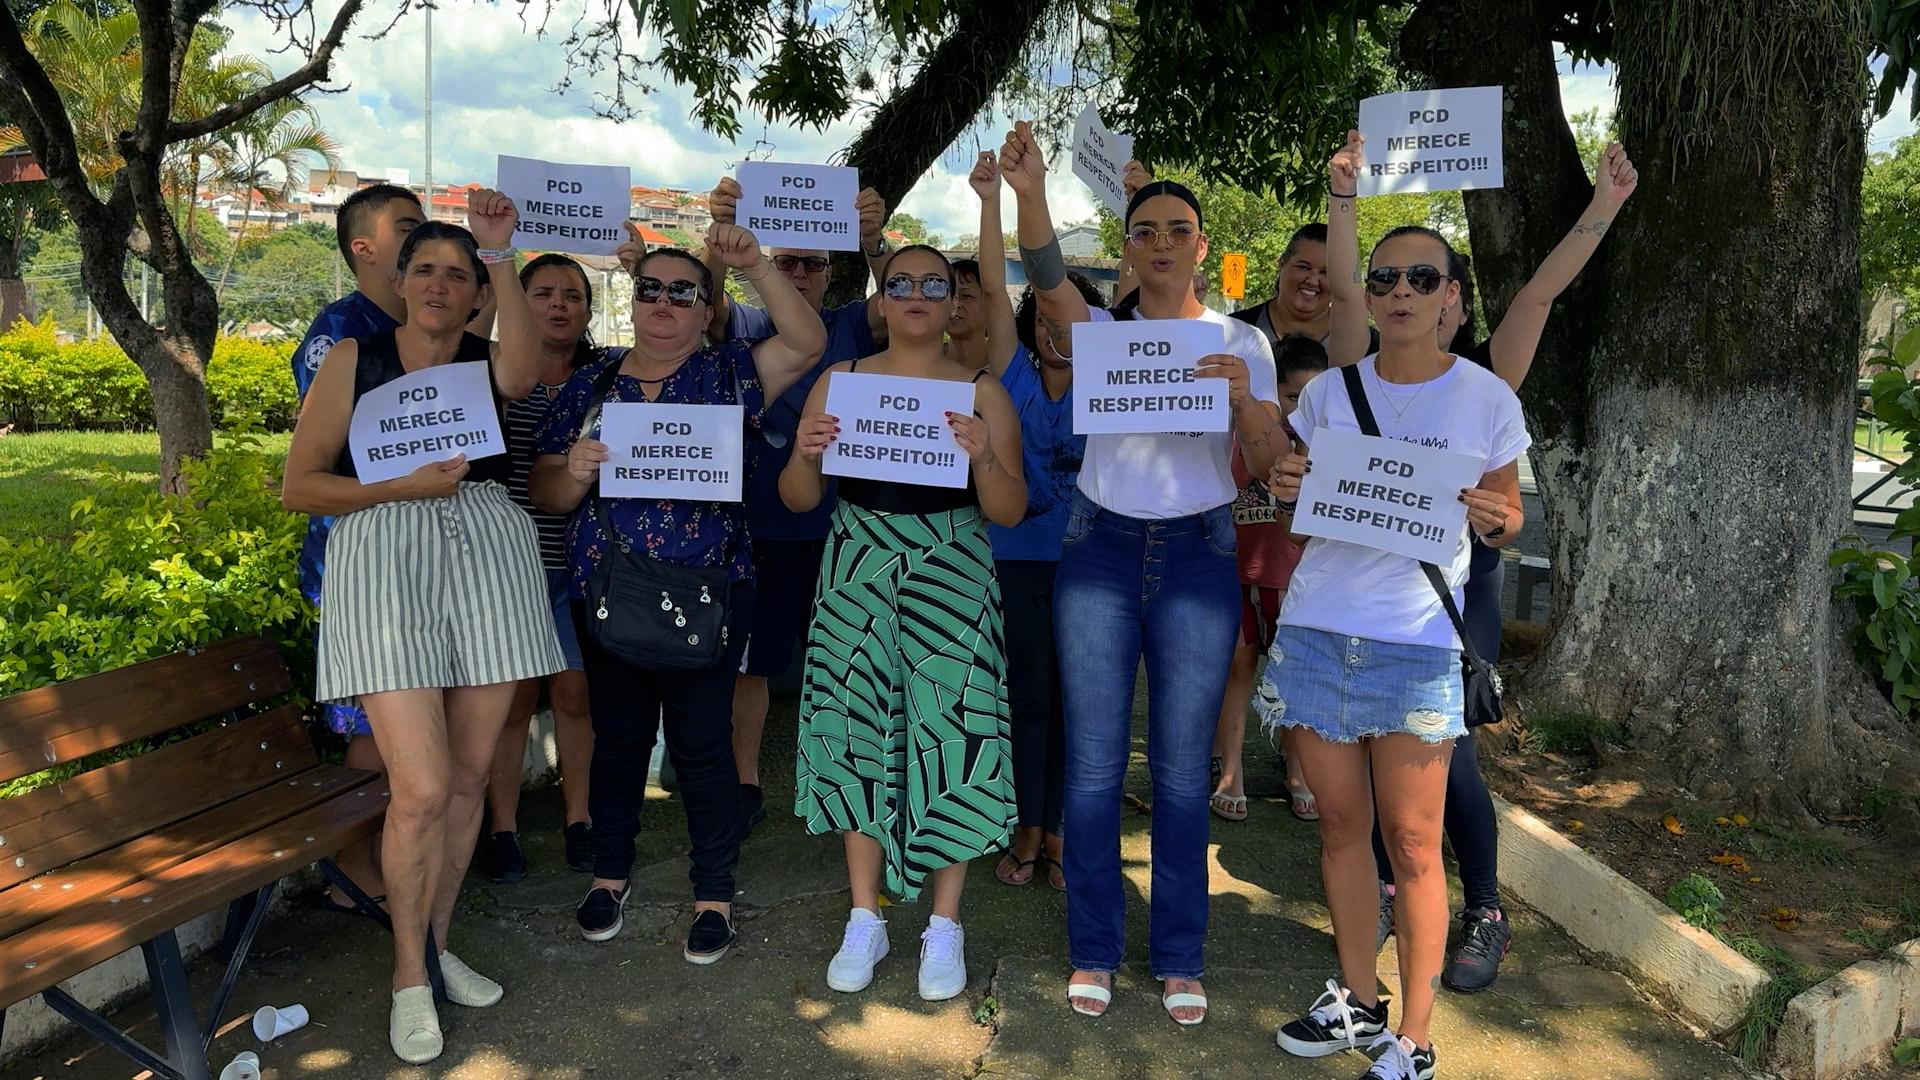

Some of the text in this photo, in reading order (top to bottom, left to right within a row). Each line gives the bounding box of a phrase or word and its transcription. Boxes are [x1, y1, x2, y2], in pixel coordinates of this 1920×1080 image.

[1409, 108, 1450, 125] PCD
[1089, 125, 1105, 149] PCD
[1387, 132, 1471, 152] MERECE
[1082, 138, 1118, 175] MERECE
[1370, 156, 1488, 177] RESPEITO!!!
[781, 176, 816, 189] PCD
[1078, 151, 1123, 201] RESPEITO!!!
[546, 179, 583, 195] PCD
[526, 199, 603, 219] MERECE
[764, 195, 834, 212] MERECE
[747, 216, 850, 236] RESPEITO!!!
[1128, 341, 1172, 358] PCD
[1106, 367, 1196, 385] MERECE
[398, 385, 439, 406] PCD
[879, 394, 921, 412] PCD
[1089, 395, 1214, 413] RESPEITO!!!
[380, 408, 465, 433] MERECE
[652, 421, 692, 436] PCD
[855, 418, 940, 441] MERECE
[367, 430, 488, 463] RESPEITO!!!
[631, 445, 713, 460] MERECE
[837, 442, 956, 468] RESPEITO!!!
[615, 466, 729, 484] RESPEITO!!!
[1367, 456, 1415, 479] PCD
[1338, 480, 1432, 510] MERECE
[1312, 502, 1444, 543] RESPEITO!!!
